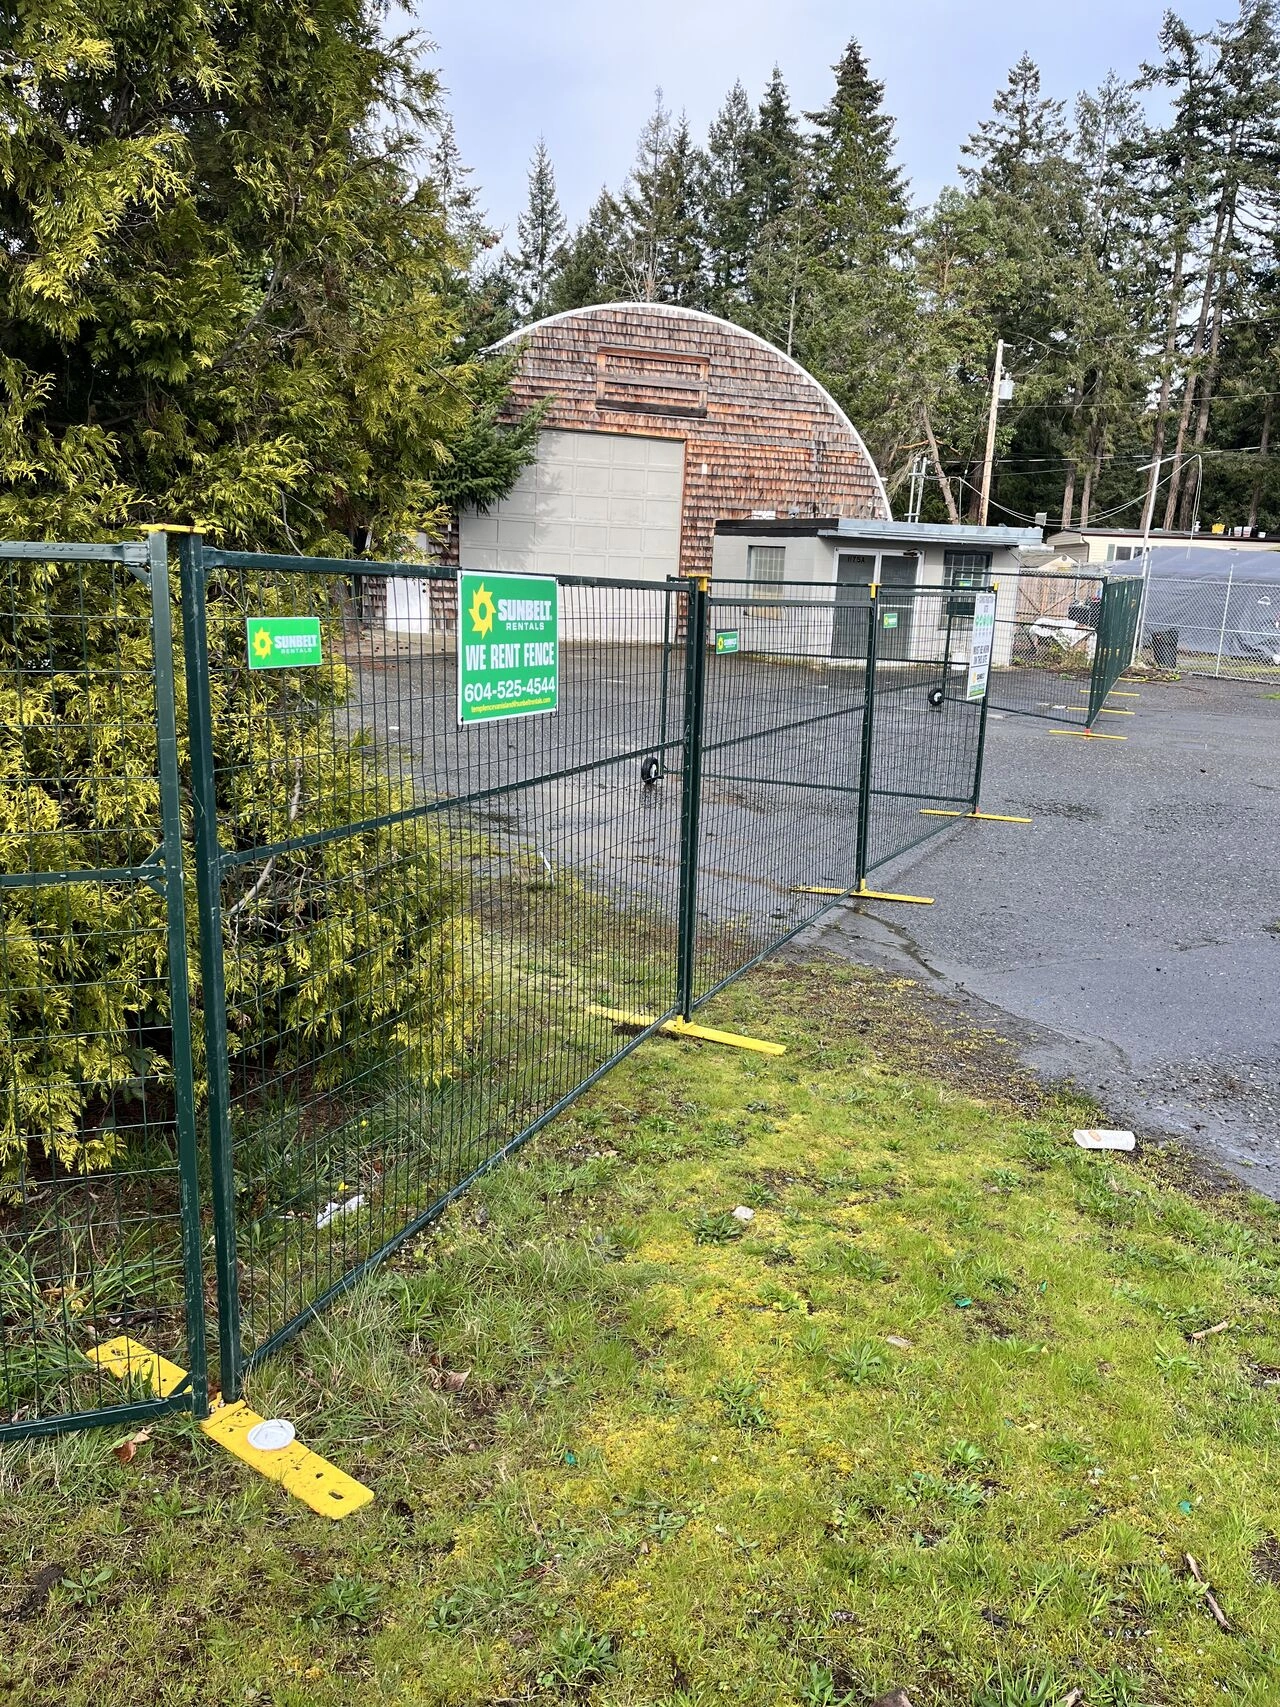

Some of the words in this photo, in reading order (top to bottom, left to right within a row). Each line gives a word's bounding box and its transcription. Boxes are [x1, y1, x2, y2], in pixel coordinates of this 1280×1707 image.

[497, 599, 552, 621] SUNBELT
[506, 622, 545, 630] RENTALS
[465, 645, 486, 671] WE
[490, 643, 521, 669] RENT
[523, 642, 555, 667] FENCE
[465, 676, 555, 702] 604-525-4544
